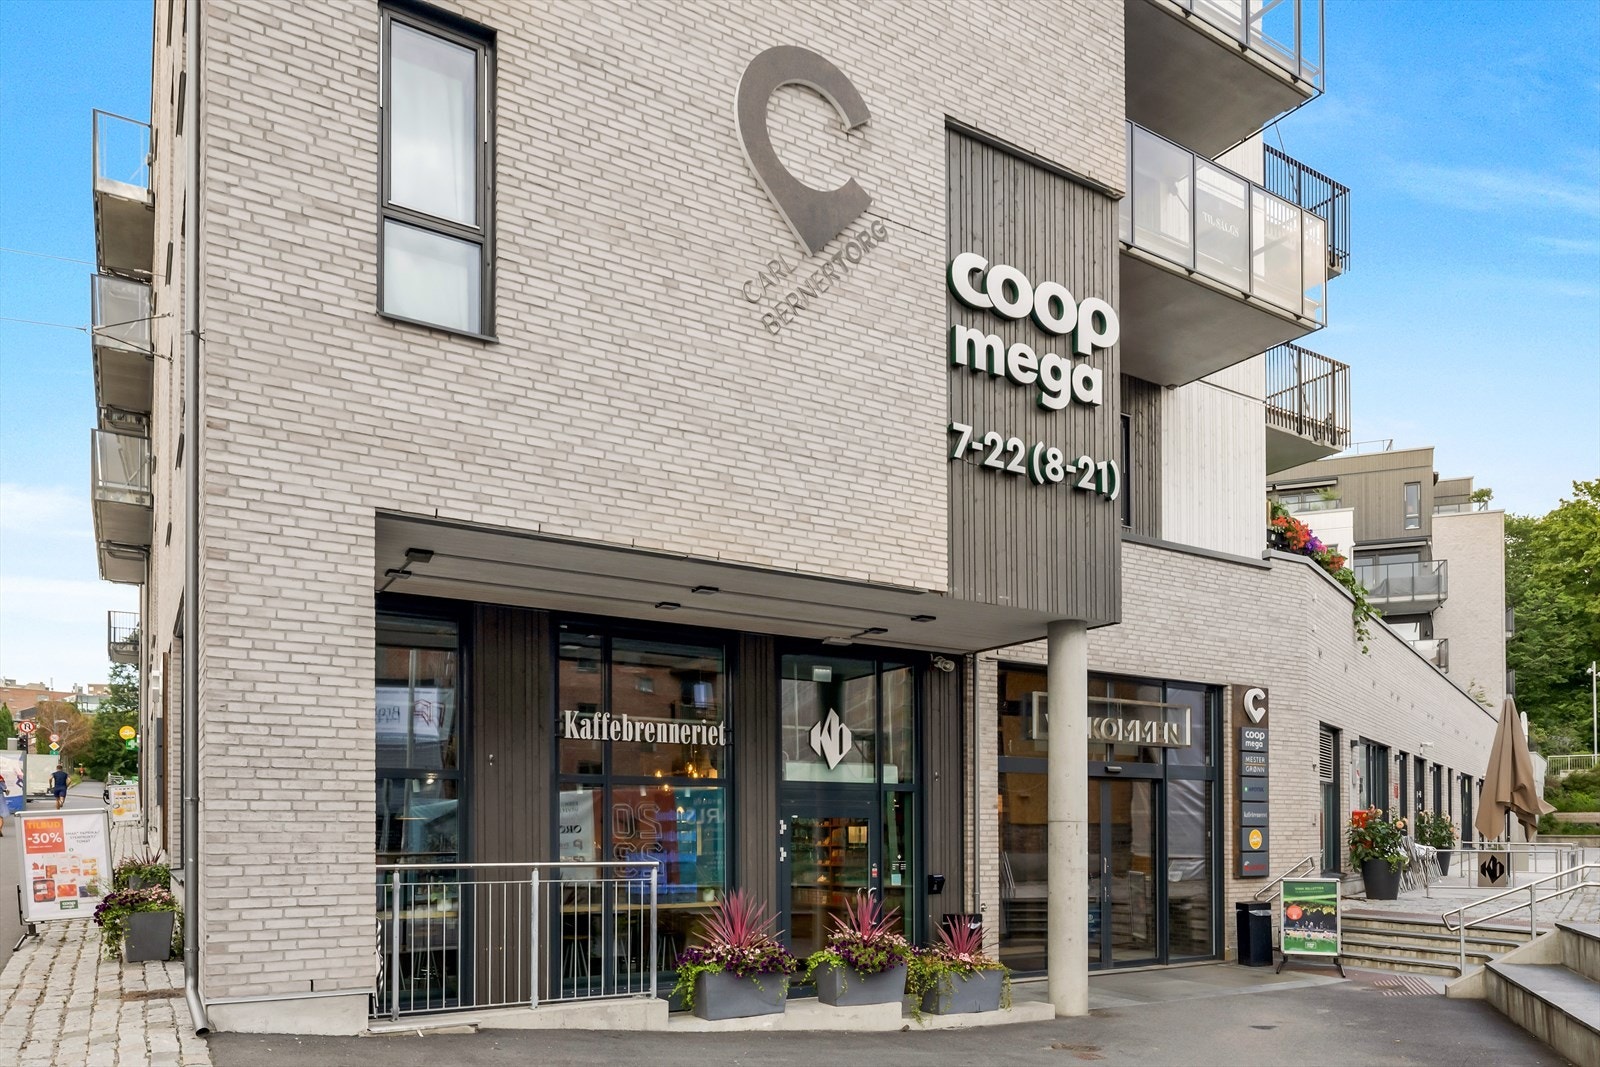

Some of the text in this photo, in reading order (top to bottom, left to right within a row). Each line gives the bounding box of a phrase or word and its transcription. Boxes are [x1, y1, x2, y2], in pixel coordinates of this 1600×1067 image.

[742, 254, 798, 304] CARL
[947, 252, 1120, 356] coop
[951, 324, 1103, 410] mega
[948, 421, 1120, 501] 7-22 (8-21)
[563, 709, 727, 746] Kaffebrenneriet
[1045, 713, 1182, 745] KOMMEN
[1245, 731, 1265, 740] coop
[1245, 740, 1264, 749] mega
[27, 821, 61, 829] TILBUD
[27, 832, 63, 844] -30%
